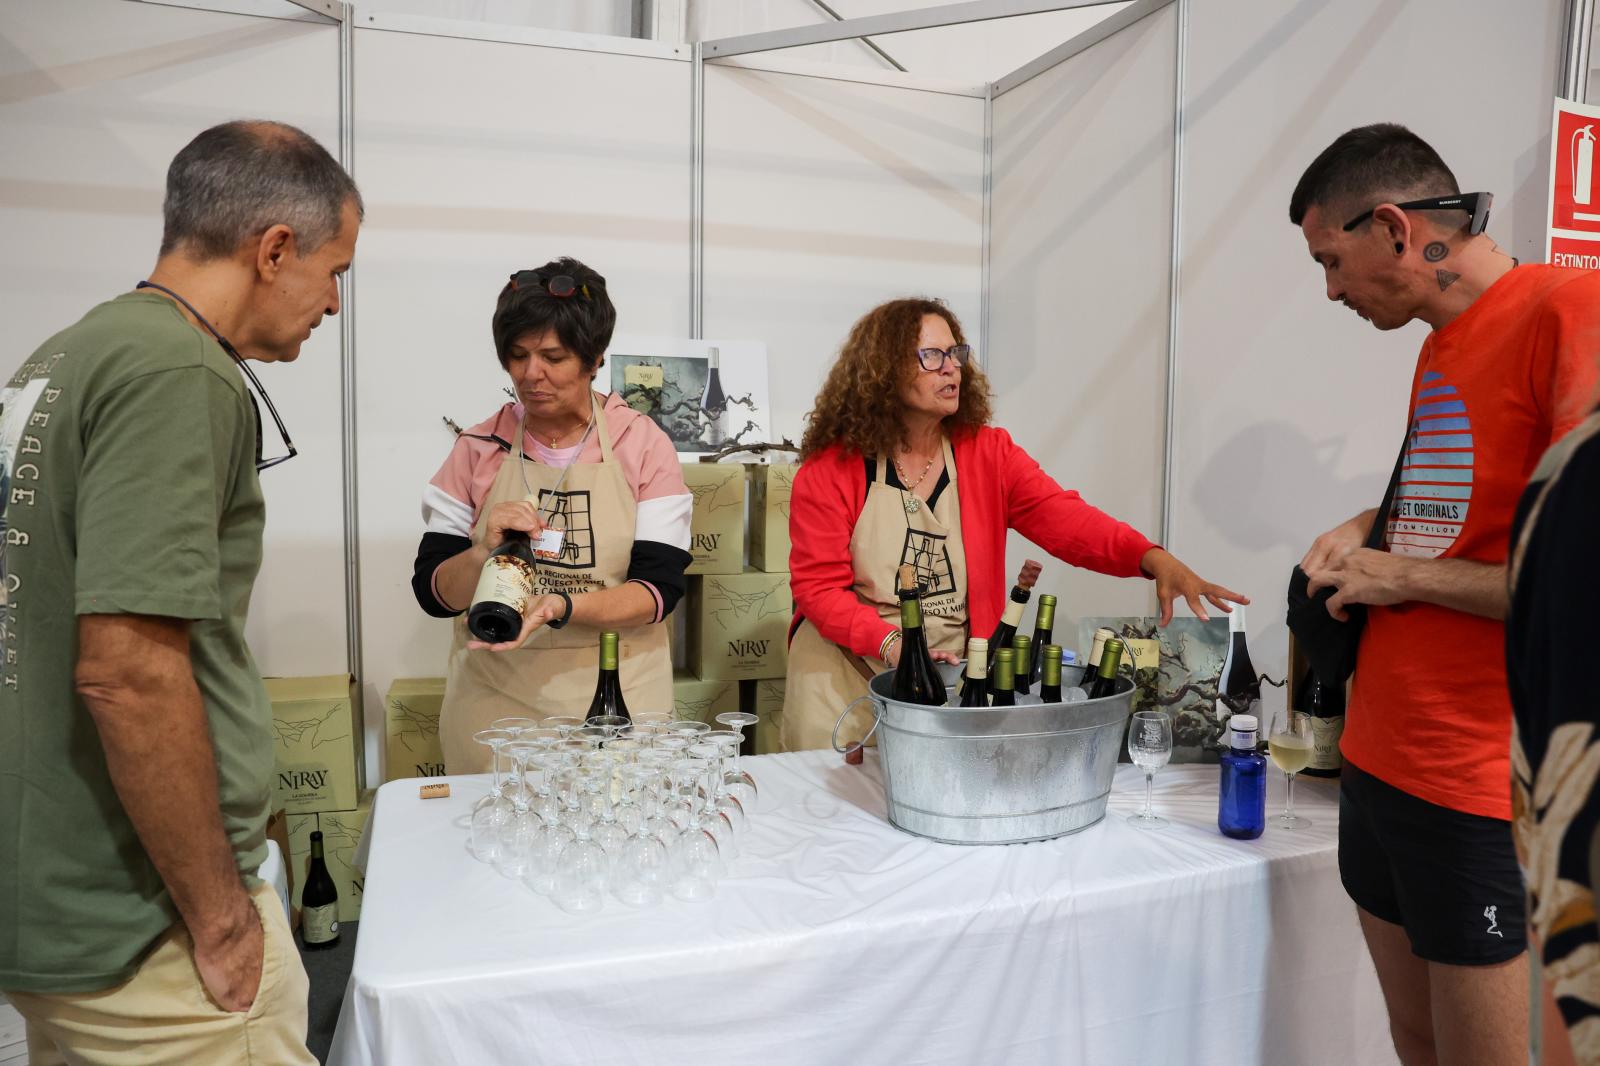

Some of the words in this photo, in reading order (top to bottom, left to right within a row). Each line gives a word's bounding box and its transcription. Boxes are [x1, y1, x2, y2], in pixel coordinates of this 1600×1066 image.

[1554, 252, 1600, 270] EXTINTO
[10, 387, 62, 506] PEACE
[1414, 502, 1459, 519] ORIGINALS
[7, 528, 30, 546] &
[690, 533, 721, 552] IRAY
[539, 577, 573, 586] QUESO
[544, 569, 580, 580] REGIONAL
[727, 639, 771, 657] NIRAY
[415, 762, 447, 778] NIR
[276, 769, 329, 790] NIRAY
